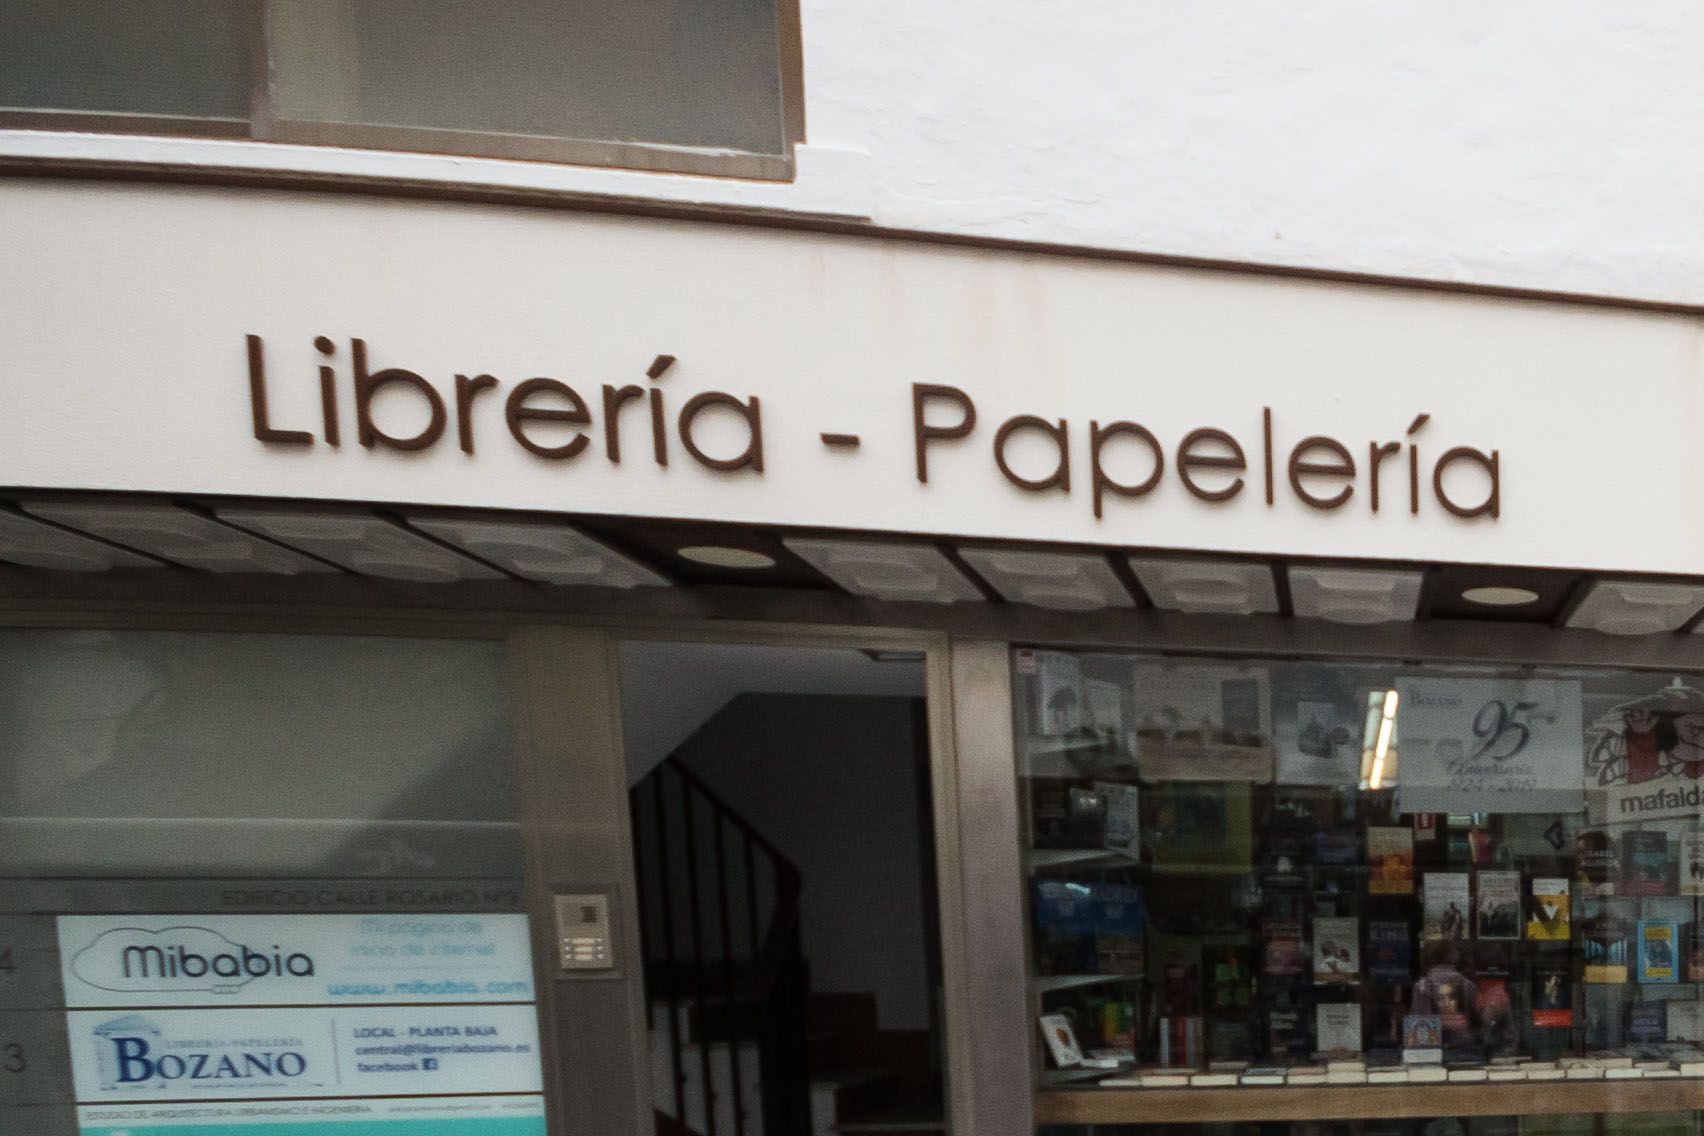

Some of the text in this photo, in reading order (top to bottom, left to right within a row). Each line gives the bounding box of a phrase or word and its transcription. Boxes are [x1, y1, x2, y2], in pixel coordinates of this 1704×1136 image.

[246, 334, 1500, 520] Librería - Papelería
[1469, 699, 1539, 761] 95
[409, 1026, 461, 1037] PLANTA
[4, 1042, 28, 1074] 3
[111, 1036, 307, 1083] BOZANO
[357, 1060, 419, 1073] facebook
